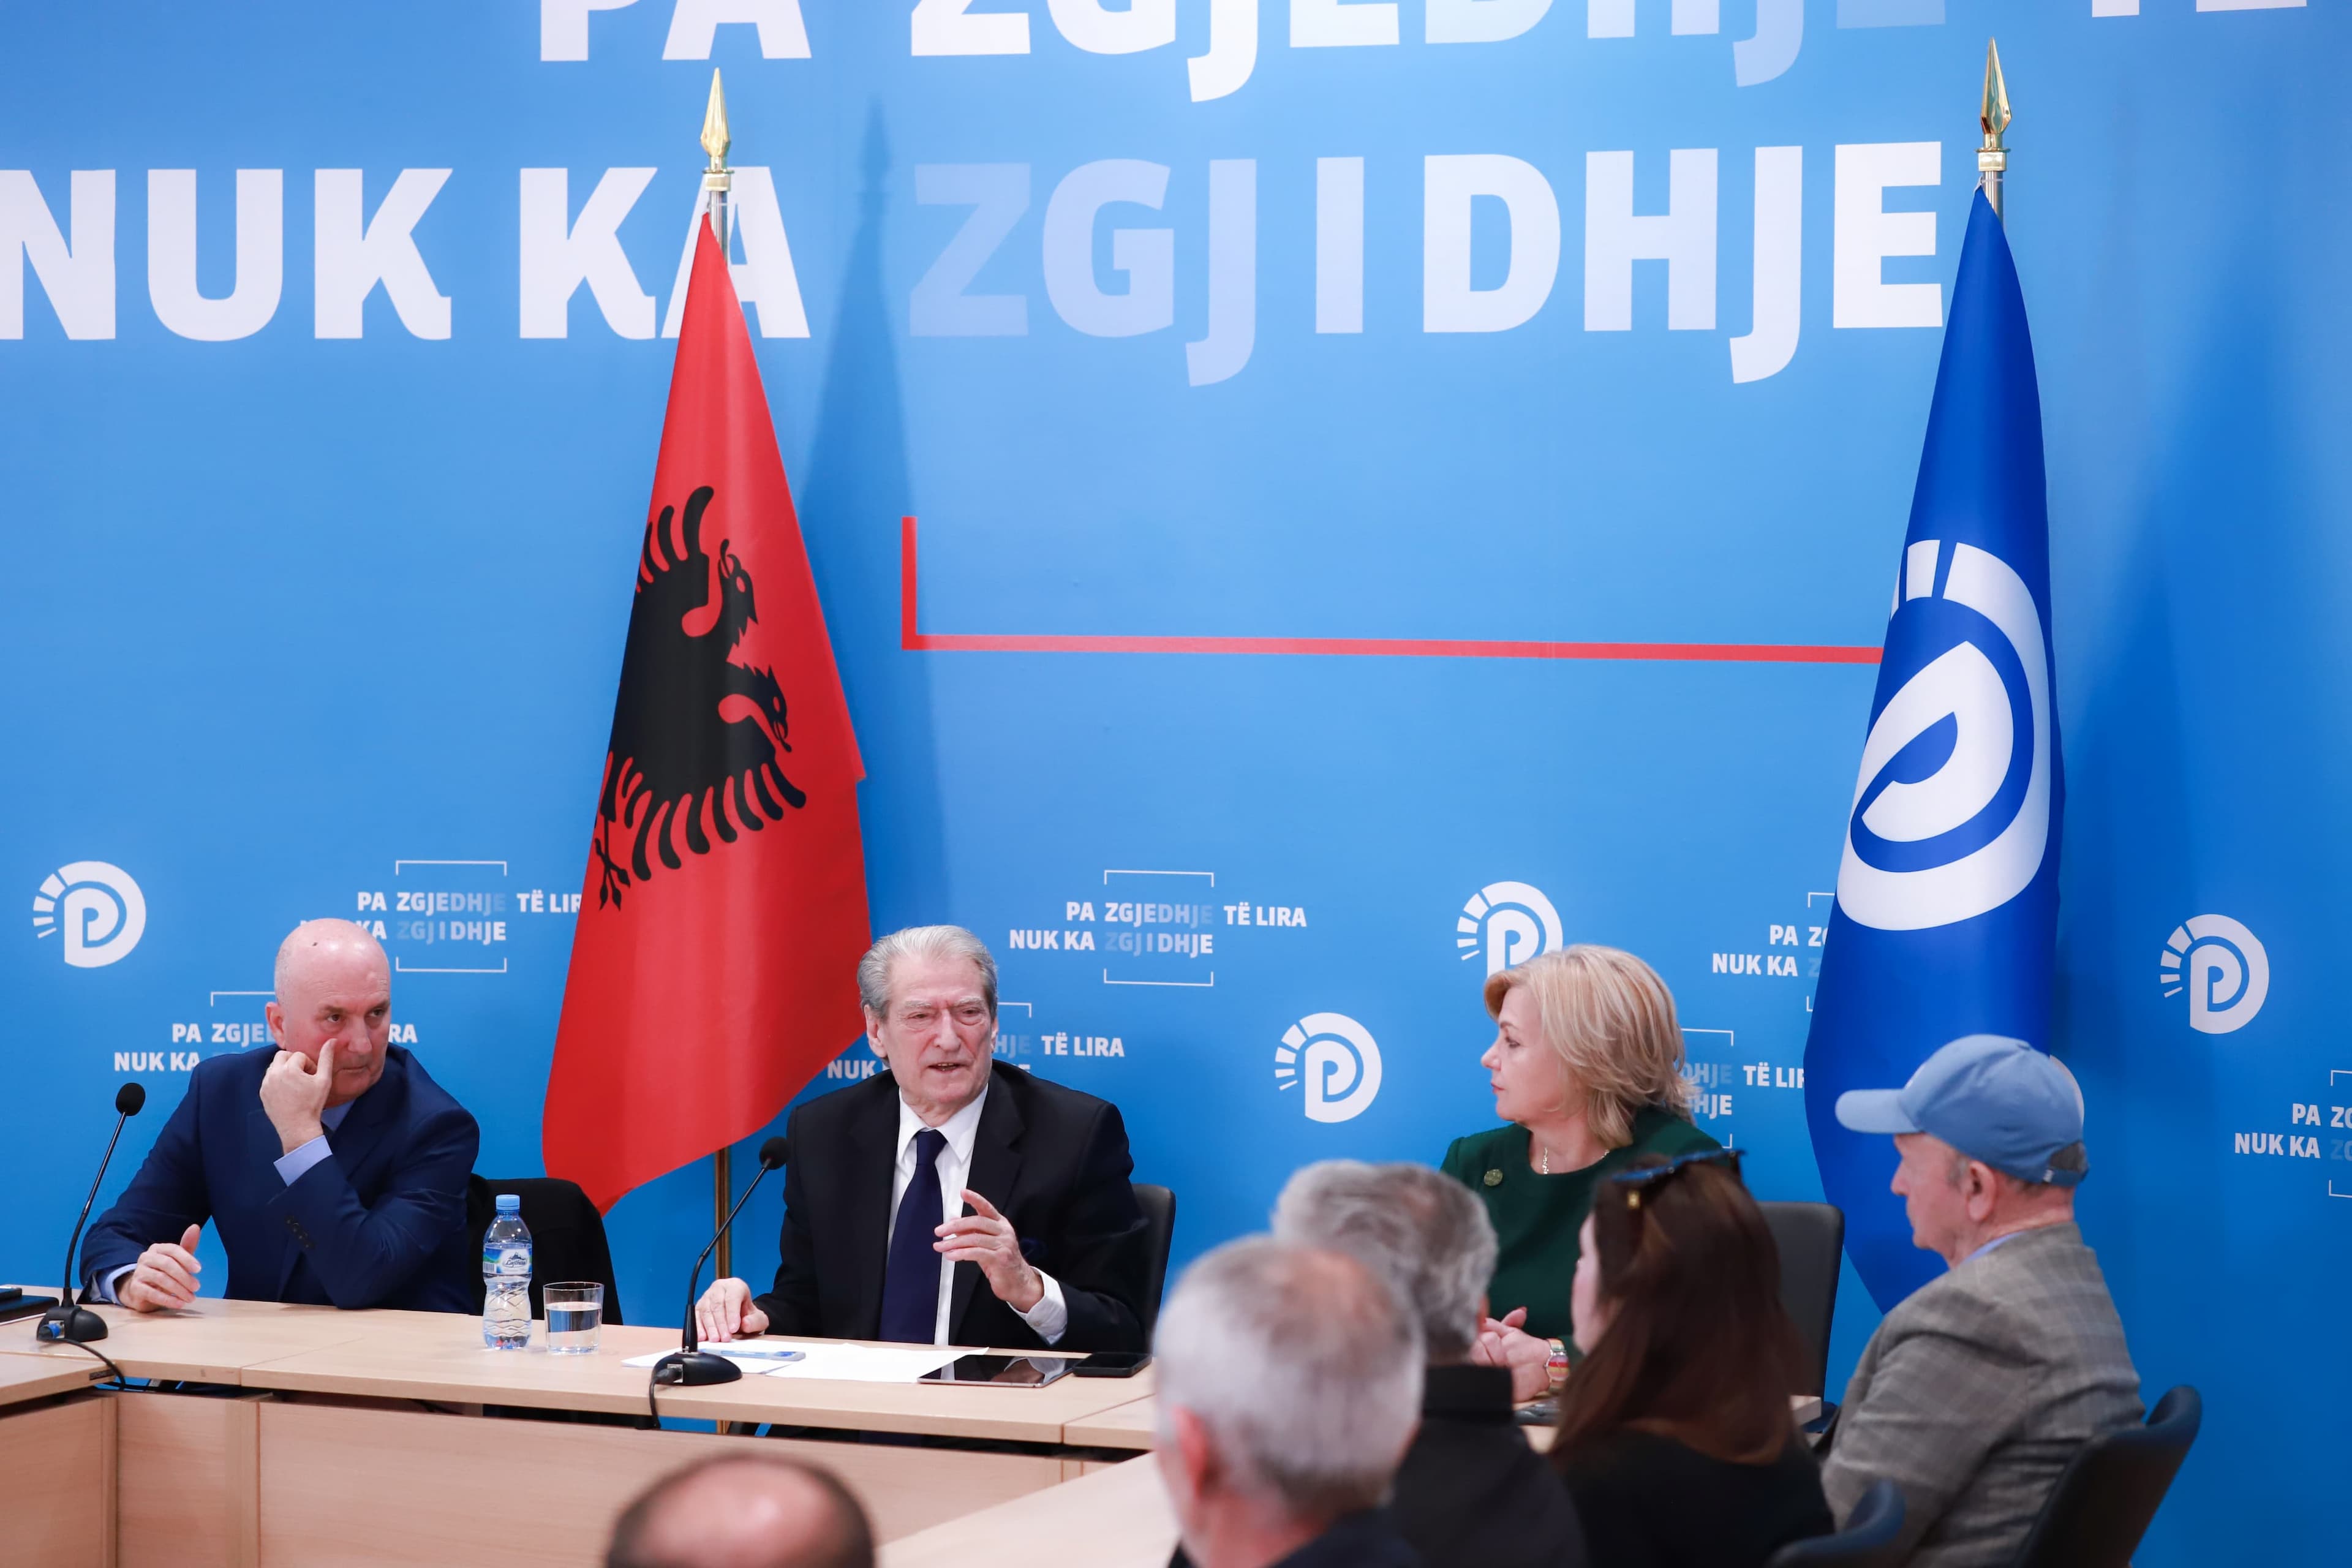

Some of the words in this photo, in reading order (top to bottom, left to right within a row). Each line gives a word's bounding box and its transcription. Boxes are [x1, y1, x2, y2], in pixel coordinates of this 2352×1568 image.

[0, 168, 453, 341] NUK
[520, 167, 811, 340] KA
[358, 892, 387, 911] PA
[396, 892, 507, 916] ZGJEDHJE
[516, 889, 544, 913] TË
[549, 894, 582, 913] LIR
[1066, 902, 1095, 921] PA
[1104, 902, 1213, 929] ZGJEDHJE
[1224, 902, 1251, 925] TË
[1256, 905, 1307, 927] LIRA
[1009, 929, 1058, 949] NUK
[1065, 930, 1095, 951] KA
[1770, 924, 1798, 946] PA
[1713, 953, 1762, 975] NUK
[1767, 956, 1798, 977] KA
[172, 1023, 202, 1042] PA
[211, 1023, 277, 1048] ZGJE
[388, 1023, 418, 1043] RA
[1041, 1032, 1068, 1055] TË
[1074, 1036, 1125, 1057] LIRA
[114, 1052, 165, 1071] NUK
[170, 1052, 200, 1071] KA
[827, 1060, 876, 1079] NUK
[1743, 1061, 1770, 1087] TË
[1776, 1067, 1804, 1088] LIR
[2293, 1103, 2321, 1126] PA
[2235, 1133, 2283, 1156] NUK
[2290, 1136, 2321, 1158] KA
